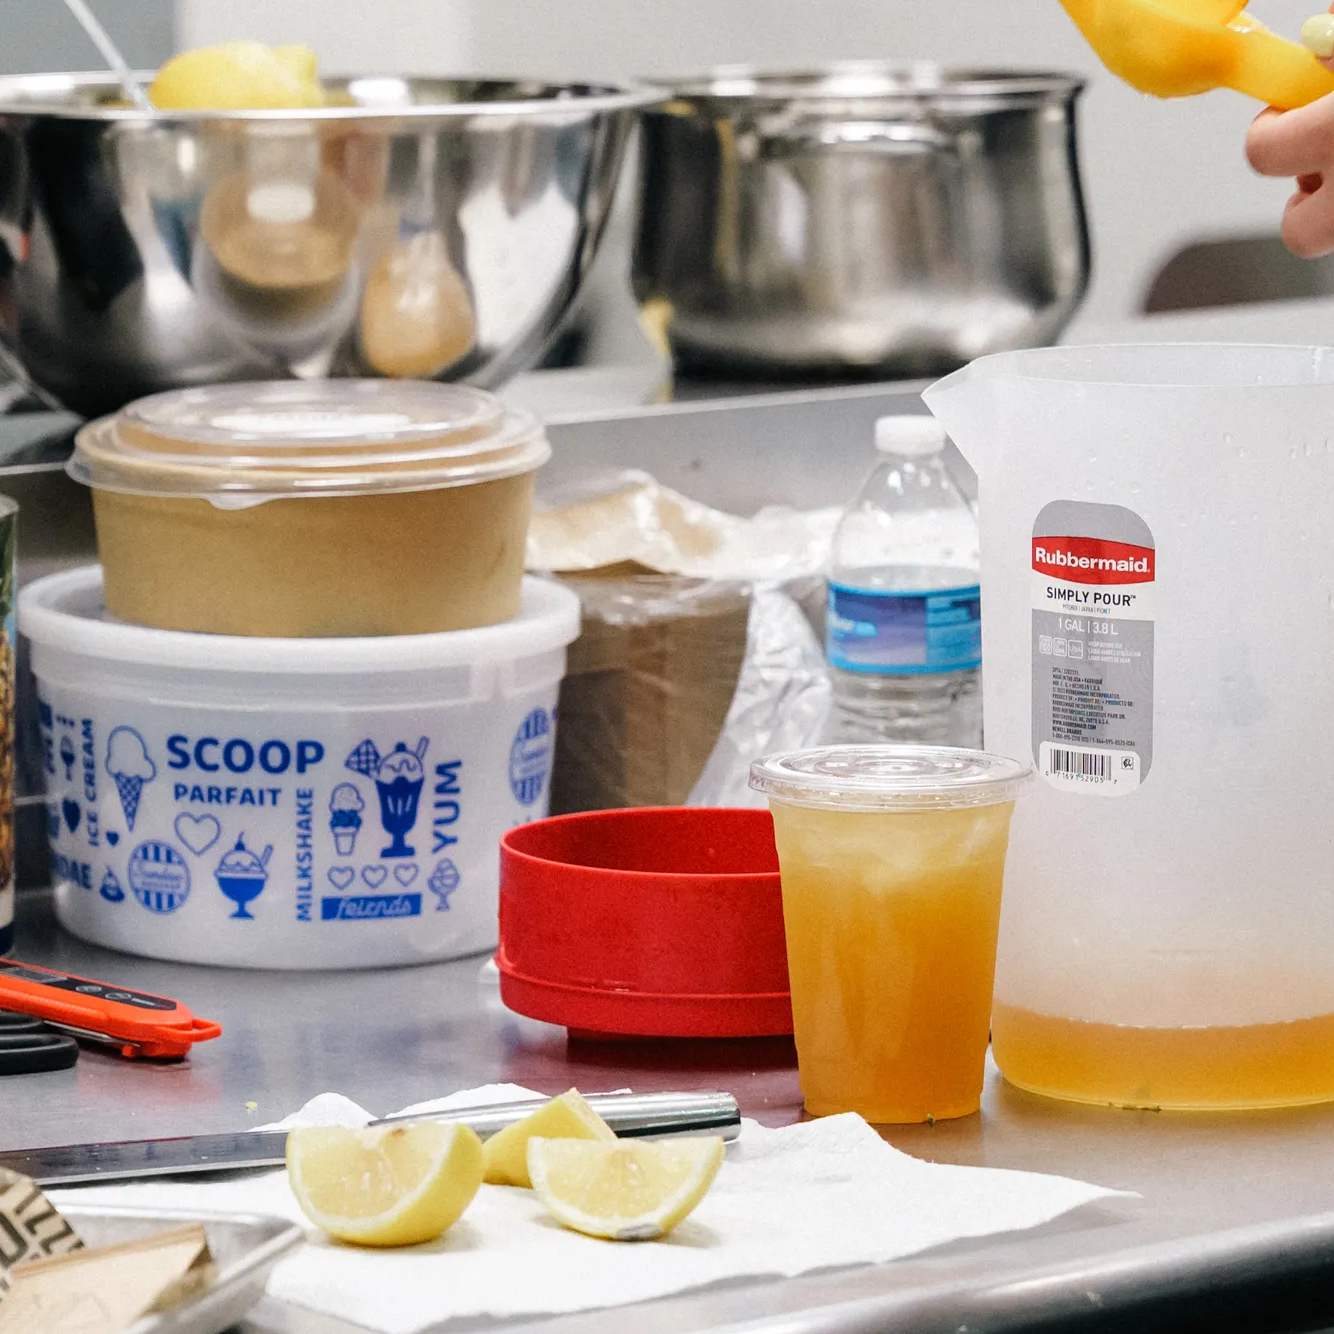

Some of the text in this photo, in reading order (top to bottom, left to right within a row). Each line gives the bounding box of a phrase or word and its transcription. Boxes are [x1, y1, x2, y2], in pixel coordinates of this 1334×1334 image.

[1035, 547, 1148, 573] Rubbermaid
[1046, 586, 1090, 603] SIMPLY
[1064, 618, 1086, 633] GAL
[1092, 621, 1109, 635] 3.8
[1110, 622, 1119, 636] L
[165, 733, 326, 775] SCOOP
[173, 782, 282, 807] PARFAIT
[431, 759, 463, 855] YUM
[295, 787, 314, 922] MILKSHAKE
